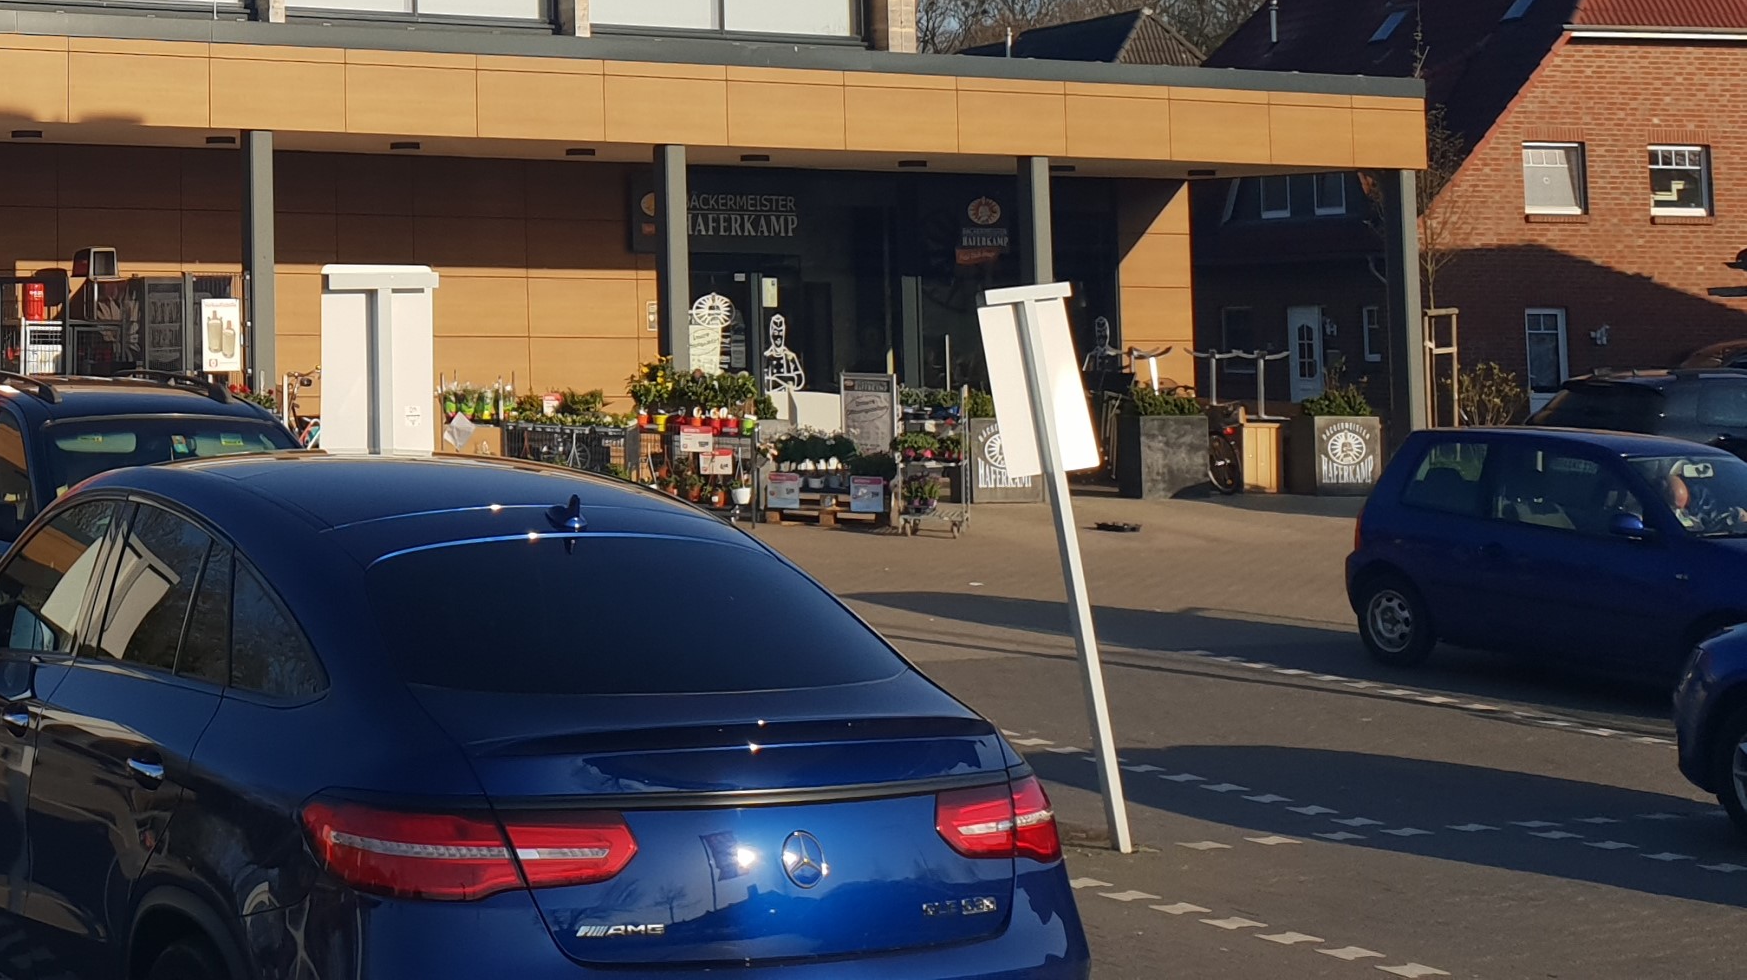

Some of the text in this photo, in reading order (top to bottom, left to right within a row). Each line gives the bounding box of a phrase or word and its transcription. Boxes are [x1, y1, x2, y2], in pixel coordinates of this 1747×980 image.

[687, 192, 796, 211] ÄCKERMEISTER
[1321, 454, 1374, 484] HAFERKAMP
[605, 923, 665, 936] AMG
